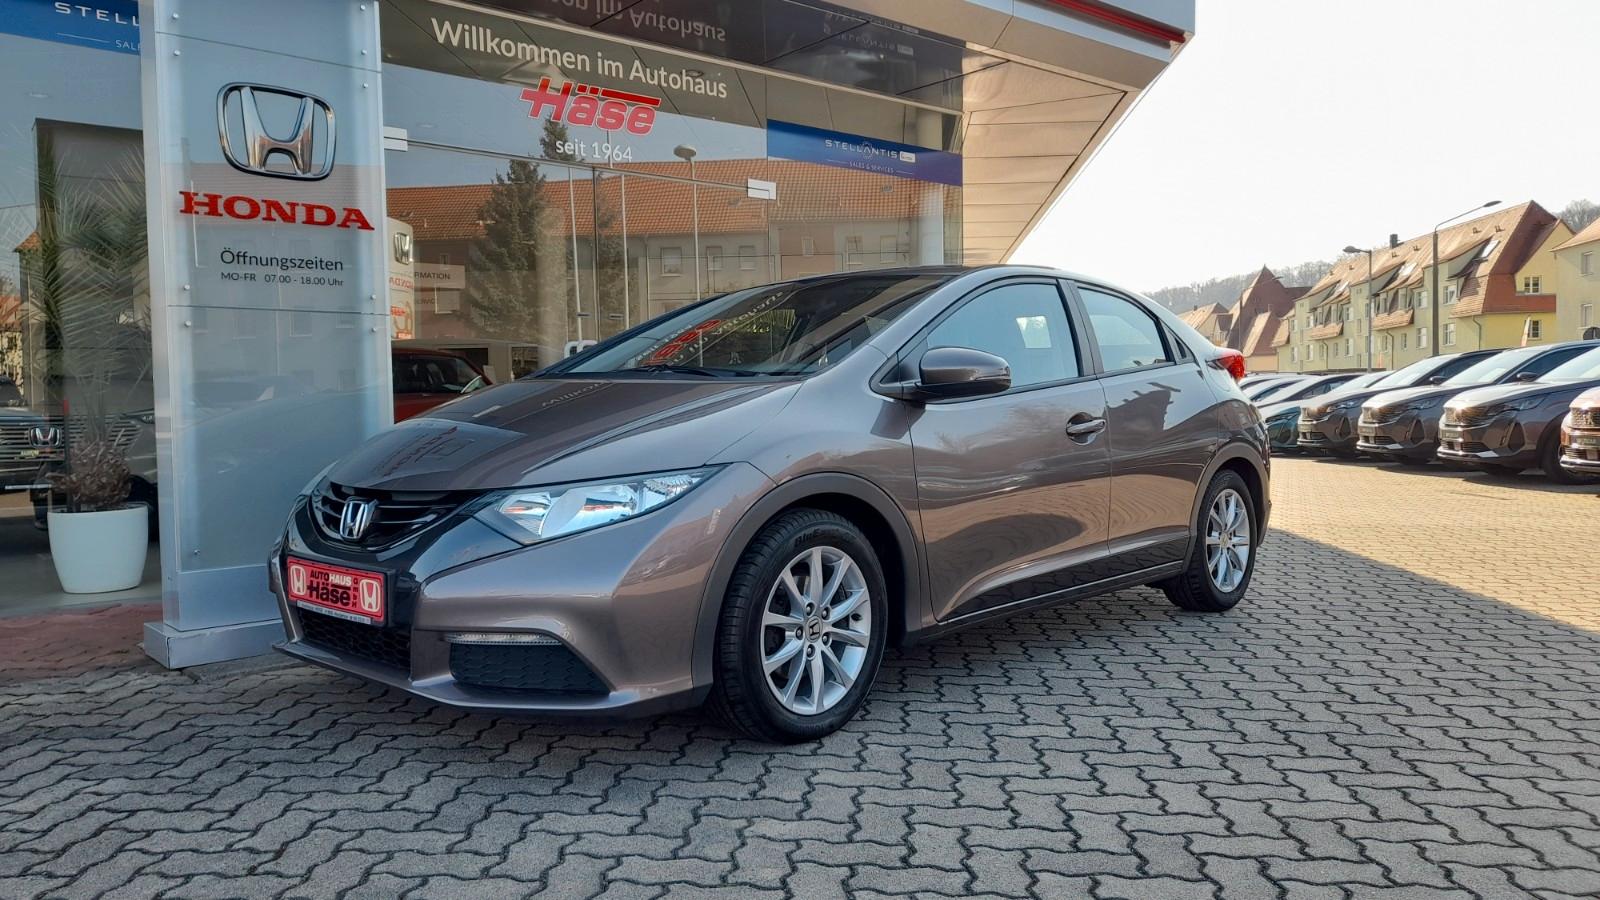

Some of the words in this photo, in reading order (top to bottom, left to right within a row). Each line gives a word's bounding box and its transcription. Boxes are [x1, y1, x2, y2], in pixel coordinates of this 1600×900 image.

[431, 17, 590, 72] Willkommen
[597, 51, 623, 78] im
[629, 60, 728, 98] Autohaus
[520, 76, 661, 135] Häse
[555, 138, 586, 157] seit
[592, 142, 633, 161] 1964
[825, 139, 897, 158] STELLANTIS
[179, 191, 375, 231] HONDA
[220, 247, 344, 271] Öffnungszeiten
[221, 272, 256, 281] MO-FR
[300, 276, 325, 286] 18.00
[327, 277, 344, 287] Uhr
[307, 580, 351, 607] Häse
